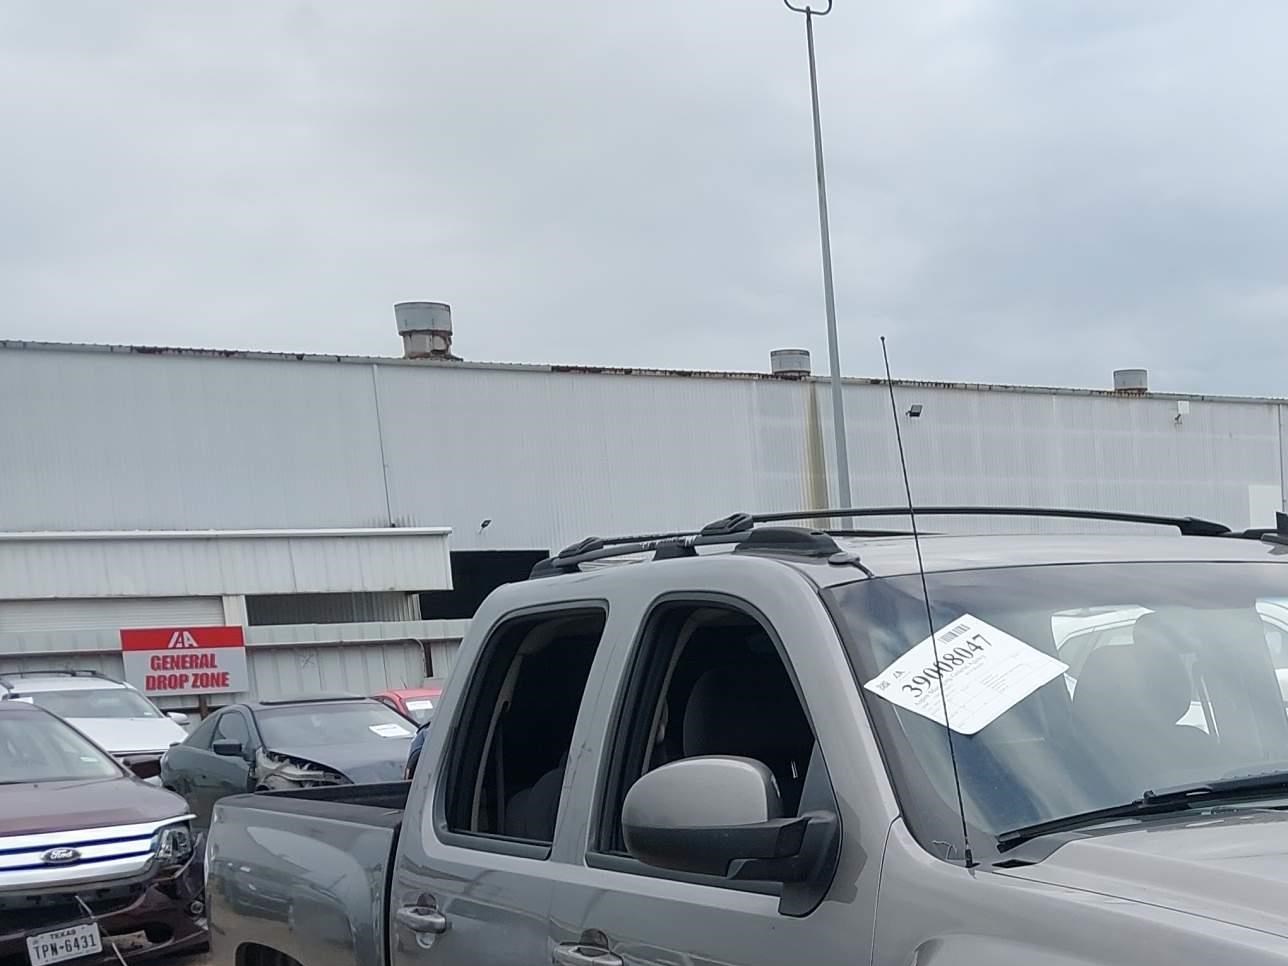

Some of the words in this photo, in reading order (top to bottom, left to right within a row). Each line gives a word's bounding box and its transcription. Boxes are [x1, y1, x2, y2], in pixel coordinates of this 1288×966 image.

[150, 653, 218, 671] GENERAL
[902, 633, 993, 699] 39008047
[145, 674, 188, 690] DROP
[191, 671, 230, 688] ZONE
[50, 848, 74, 860] Ford
[49, 929, 77, 940] TEXAS
